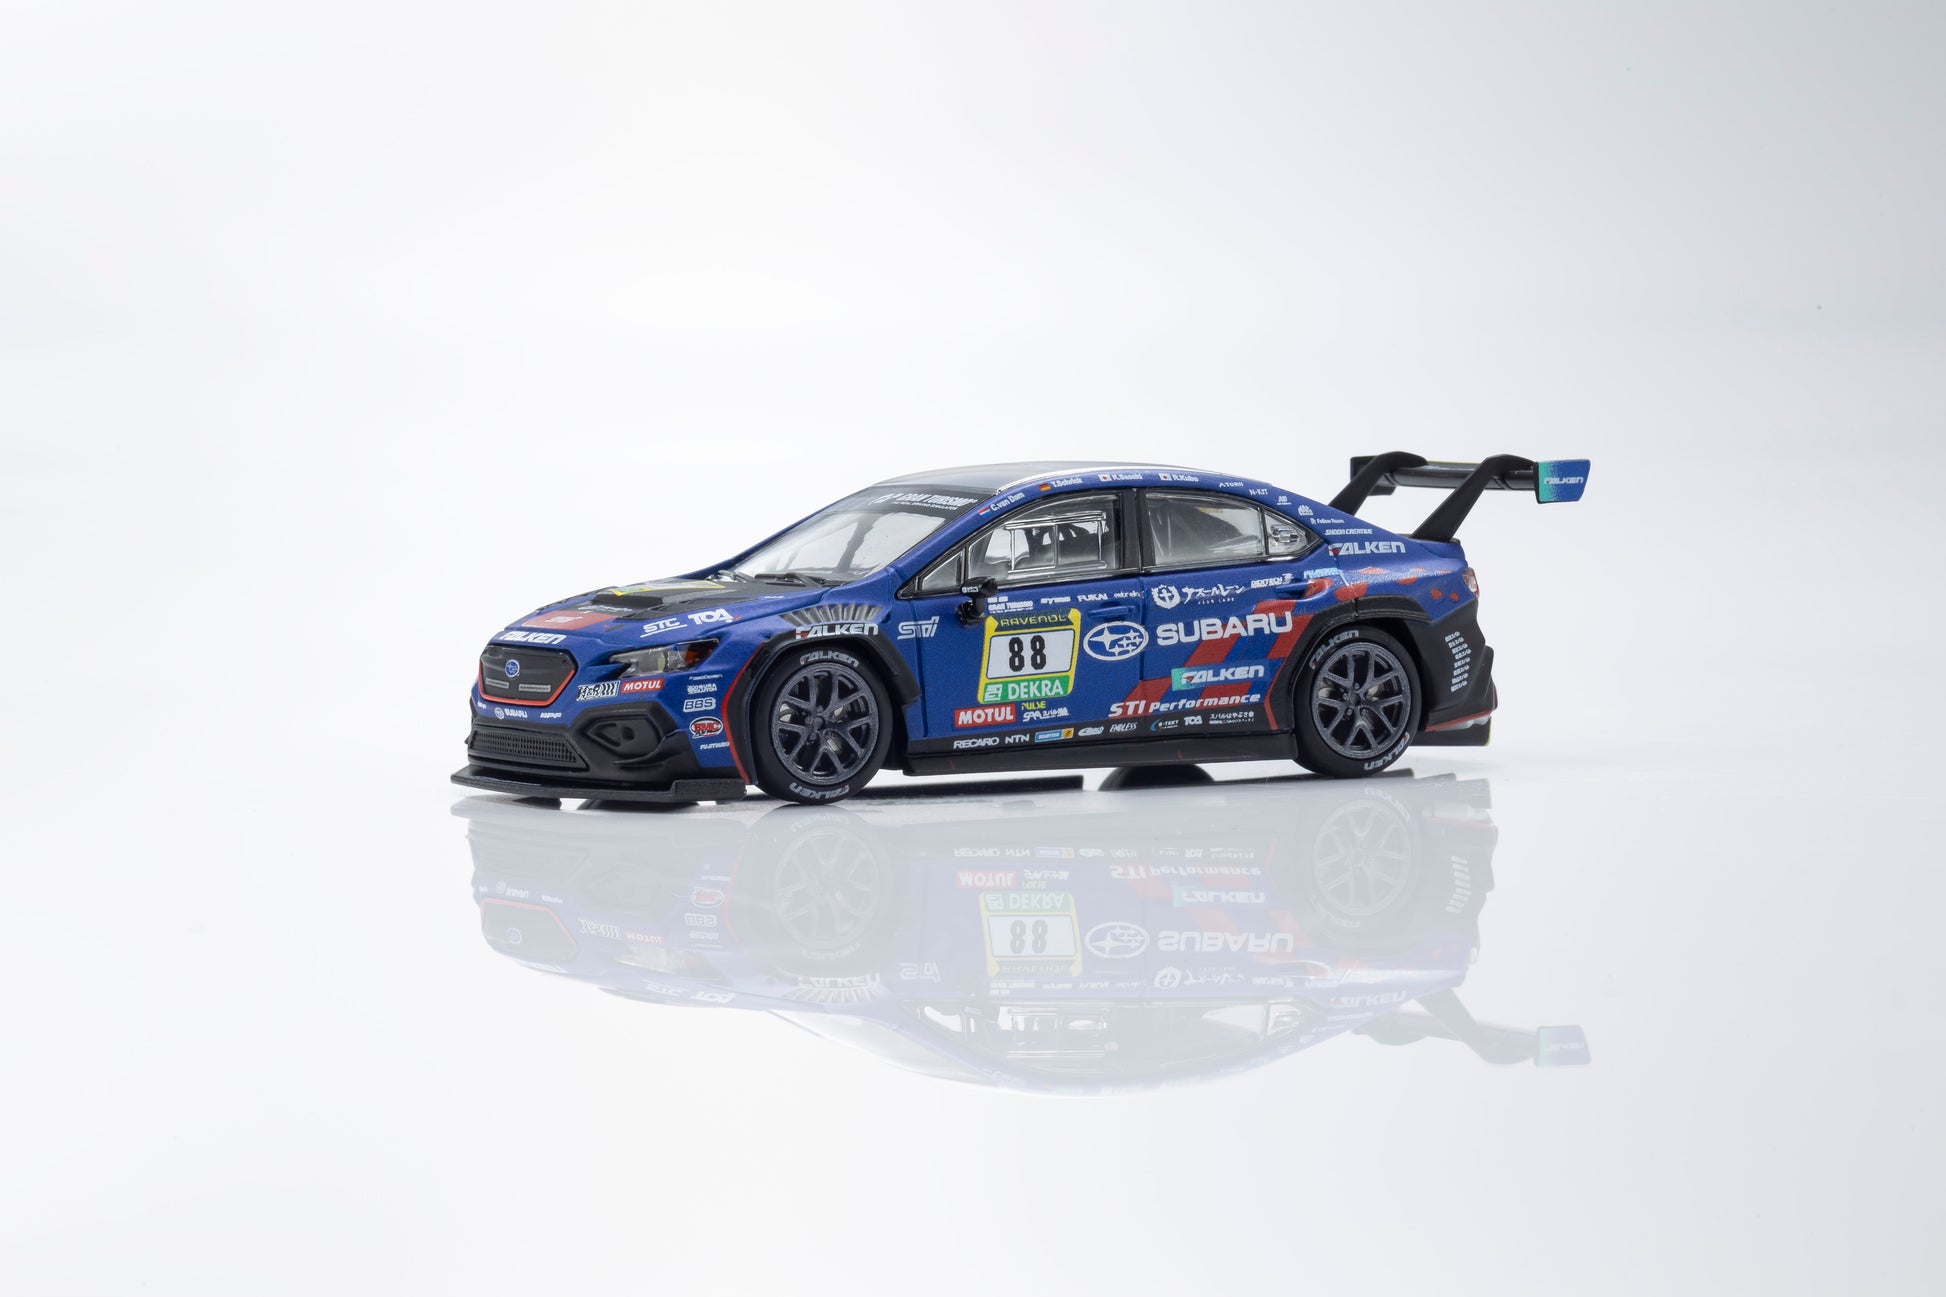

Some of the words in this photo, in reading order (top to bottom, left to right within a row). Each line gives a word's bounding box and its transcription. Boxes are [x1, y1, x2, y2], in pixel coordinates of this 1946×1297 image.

[1544, 476, 1584, 485] FALKEN
[1328, 541, 1406, 556] FALKEN
[1077, 593, 1108, 602] FUKAI
[643, 618, 681, 633] STC
[1000, 613, 1067, 627] RAVENOL
[795, 623, 879, 639] FALKEN
[1156, 611, 1293, 646] SUBARU
[500, 630, 567, 645] FALKEN
[1008, 635, 1047, 672] 88
[1309, 629, 1360, 670] FALKEN
[799, 650, 860, 668] FALKEN
[1181, 665, 1265, 684] FALKEN
[623, 679, 662, 691] MOTUL
[1008, 679, 1064, 700] DEKRA
[684, 698, 714, 710] BBS
[1108, 700, 1145, 718] STI
[1149, 693, 1261, 713] Performance
[958, 706, 1014, 725] MOTUL
[1110, 722, 1138, 733] ENDLESS
[953, 736, 1000, 749] RECARO
[1005, 733, 1030, 744] NTN
[788, 782, 850, 799] FALKEN
